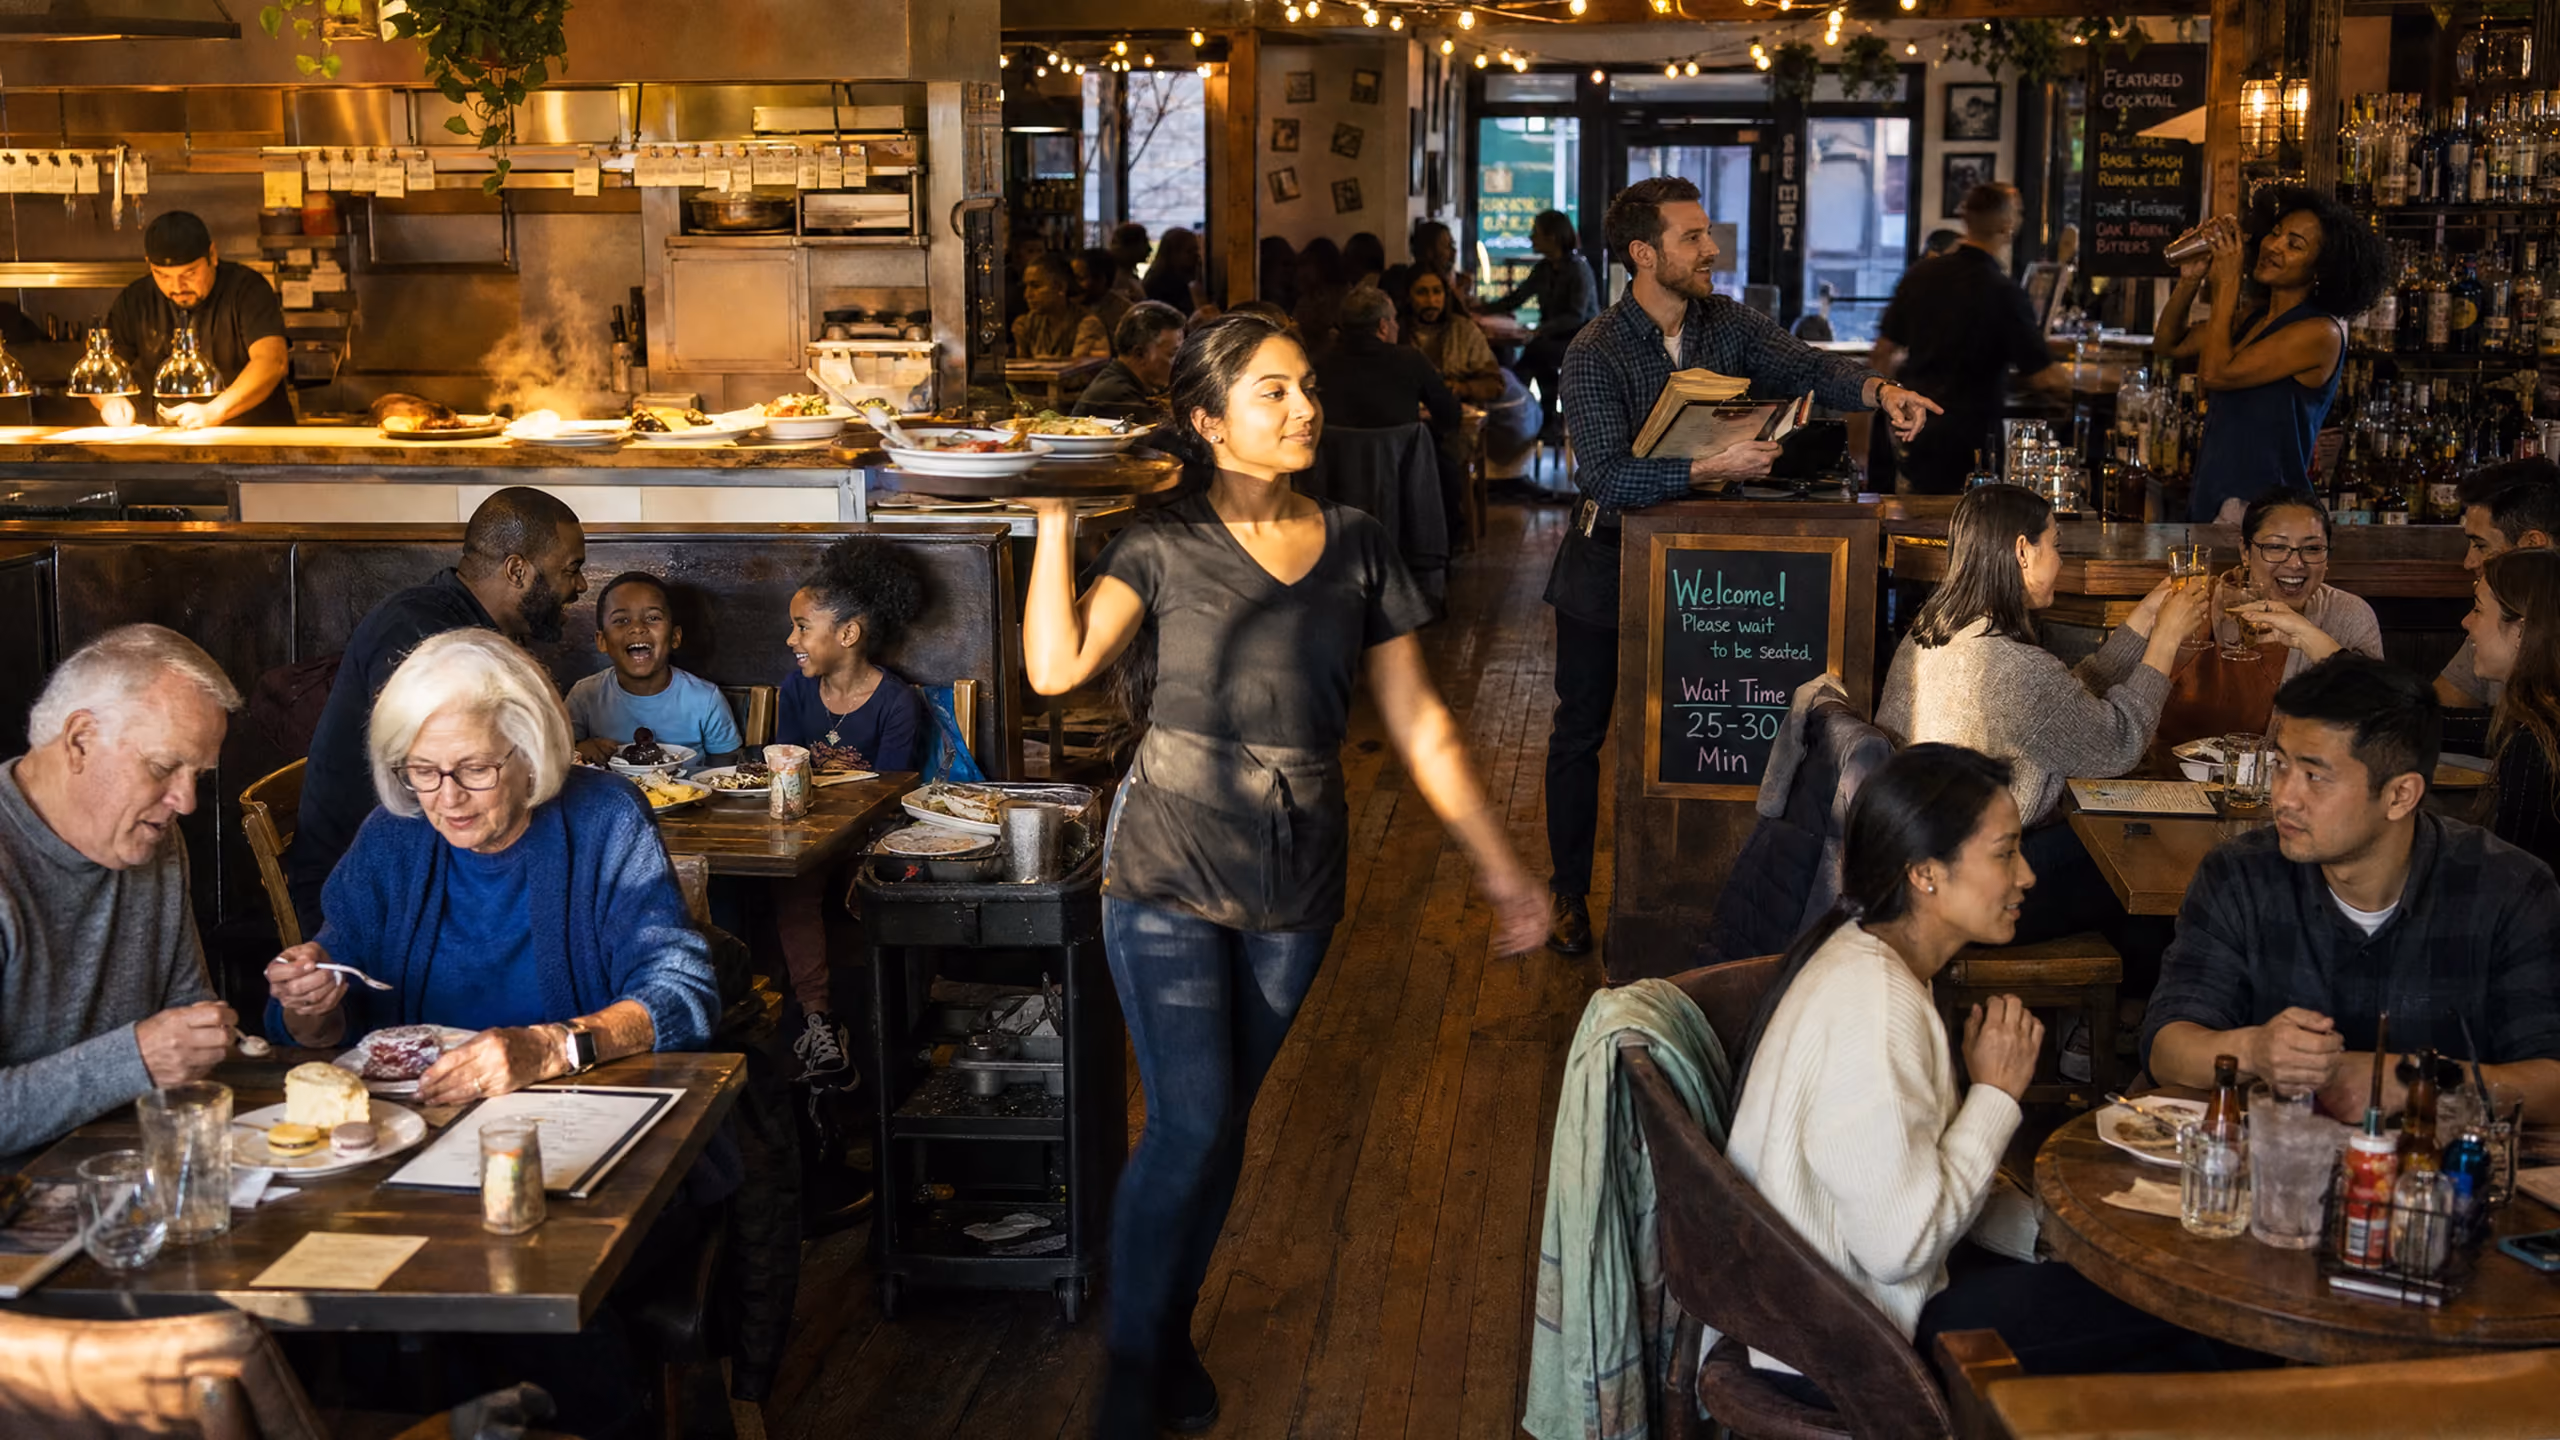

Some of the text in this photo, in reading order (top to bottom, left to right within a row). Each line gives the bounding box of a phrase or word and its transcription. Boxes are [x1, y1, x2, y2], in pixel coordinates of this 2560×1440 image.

[2103, 69, 2183, 88] FEATURED
[2101, 93, 2177, 108] COCKTAIL
[1672, 568, 1786, 611] Welcome!
[1681, 613, 1776, 634] Please wait
[1710, 640, 1813, 662] to be seated.
[1681, 677, 1786, 704] Wait Time
[1686, 711, 1778, 740] 25-30
[1697, 746, 1748, 774] Min
